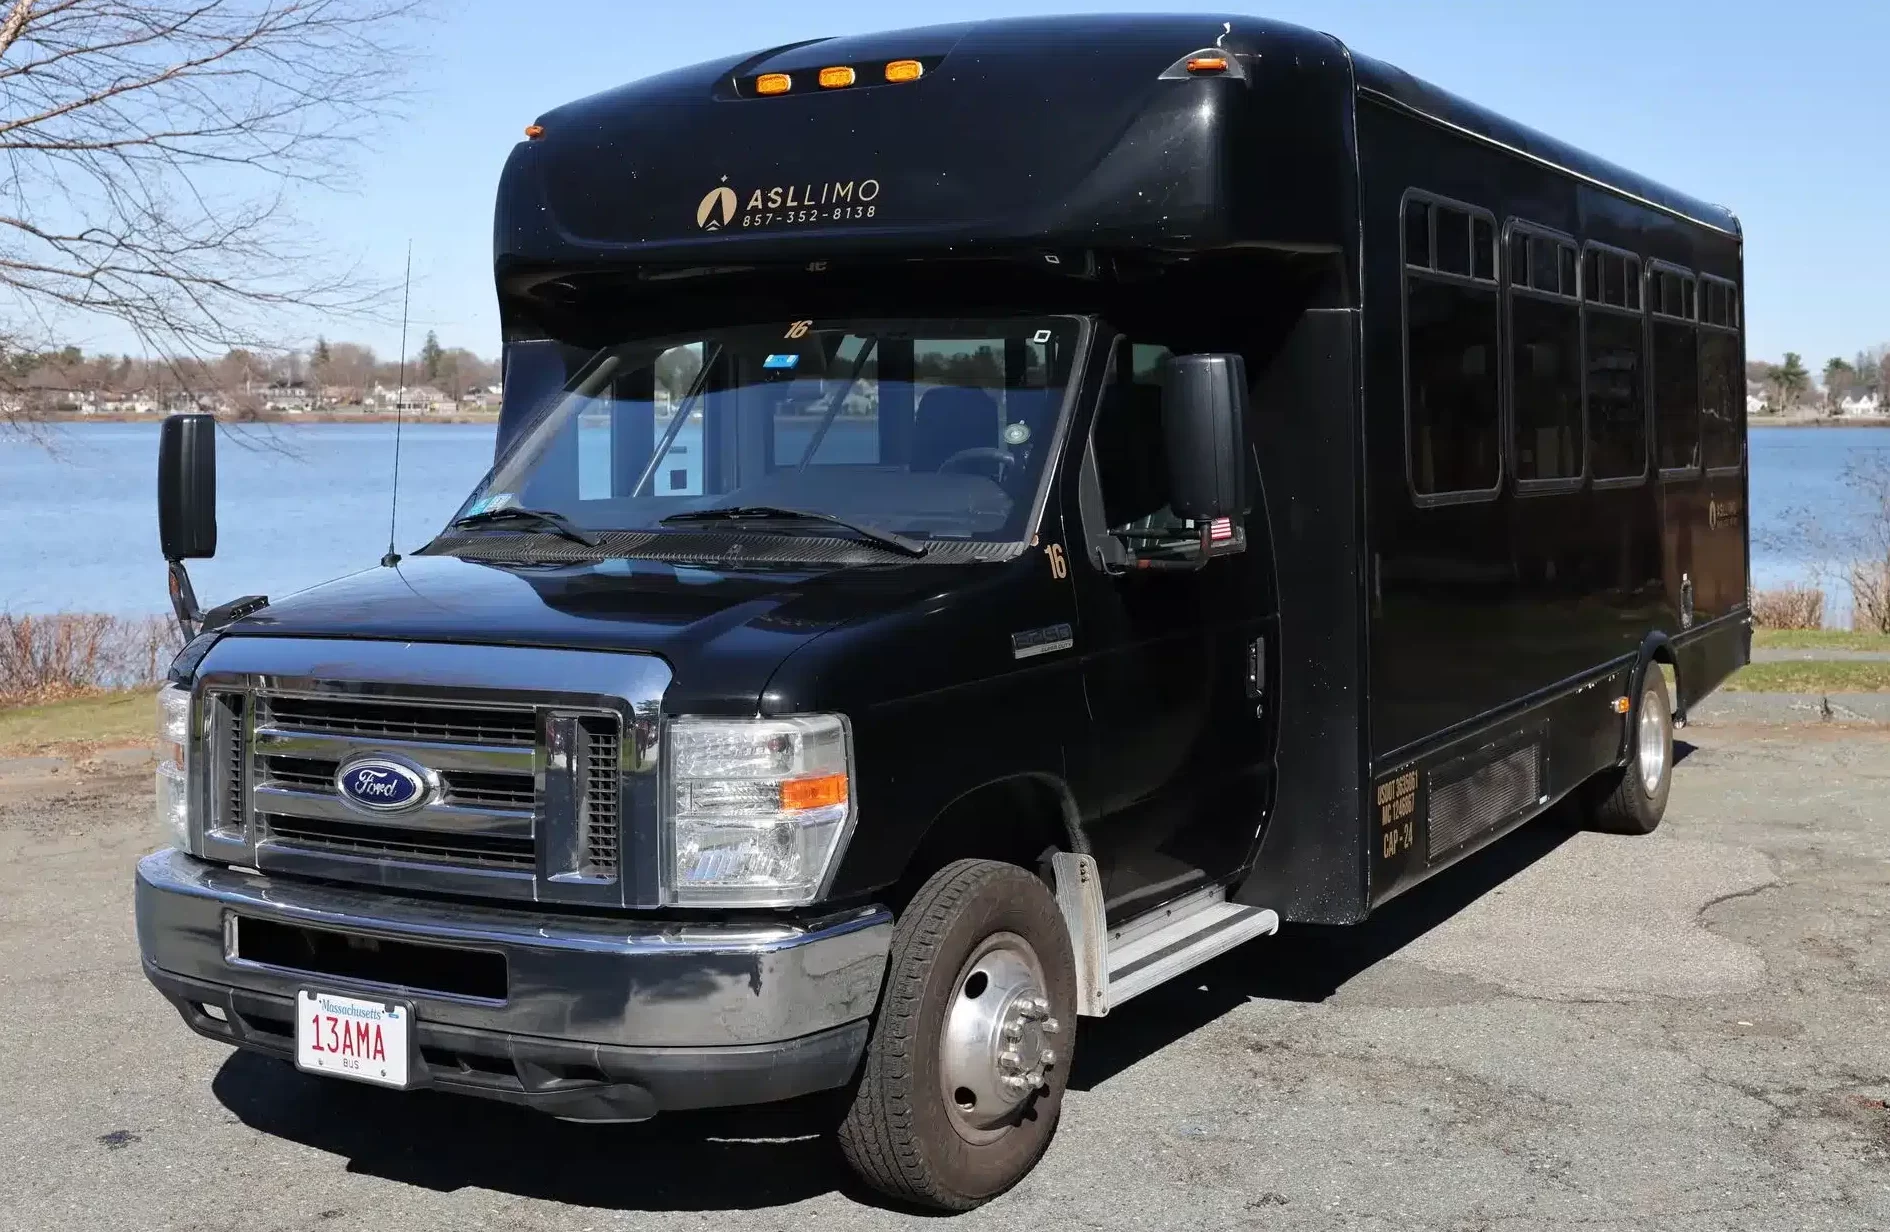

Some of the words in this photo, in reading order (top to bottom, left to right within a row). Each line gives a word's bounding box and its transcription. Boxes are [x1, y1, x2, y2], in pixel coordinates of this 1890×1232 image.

[746, 179, 880, 210] ASLLIMO
[742, 205, 876, 227] 857-352-8138
[784, 320, 813, 339] 16
[1044, 543, 1067, 579] 16
[354, 769, 398, 797] Ford
[321, 998, 381, 1020] Massachusetts
[312, 1014, 385, 1062] 13AMA
[343, 1058, 359, 1069] BUS
